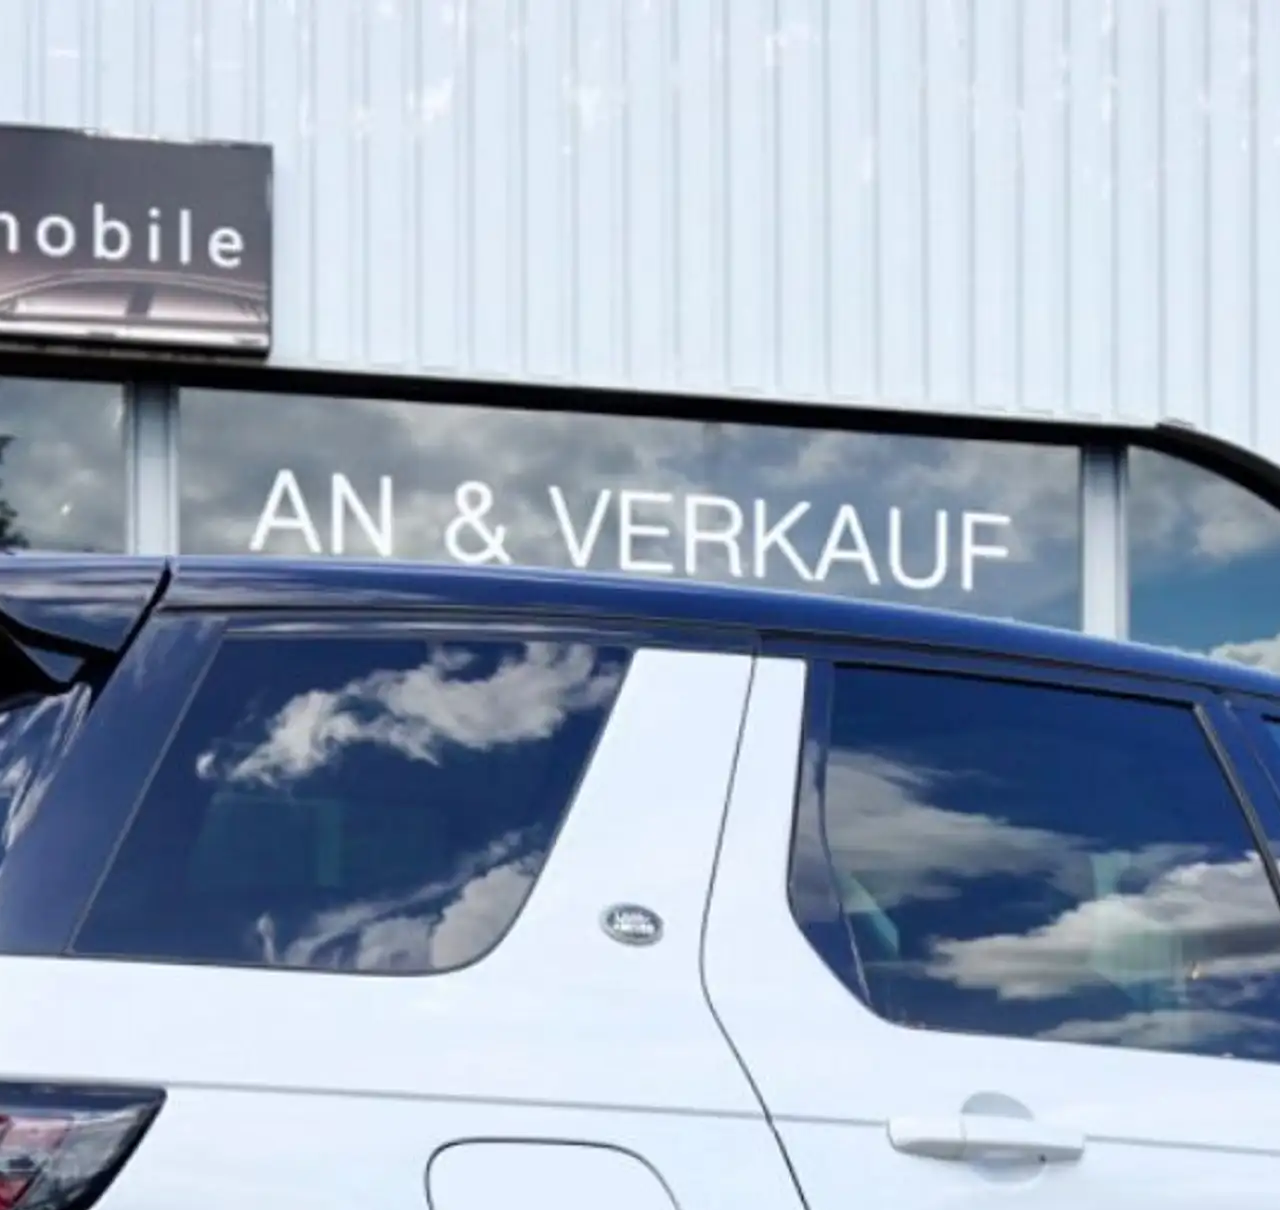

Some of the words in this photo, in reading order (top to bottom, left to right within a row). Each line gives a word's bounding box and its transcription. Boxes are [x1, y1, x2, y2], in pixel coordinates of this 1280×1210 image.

[249, 468, 393, 557] AN
[443, 480, 511, 567] &
[548, 485, 1012, 591] VERKAUF
